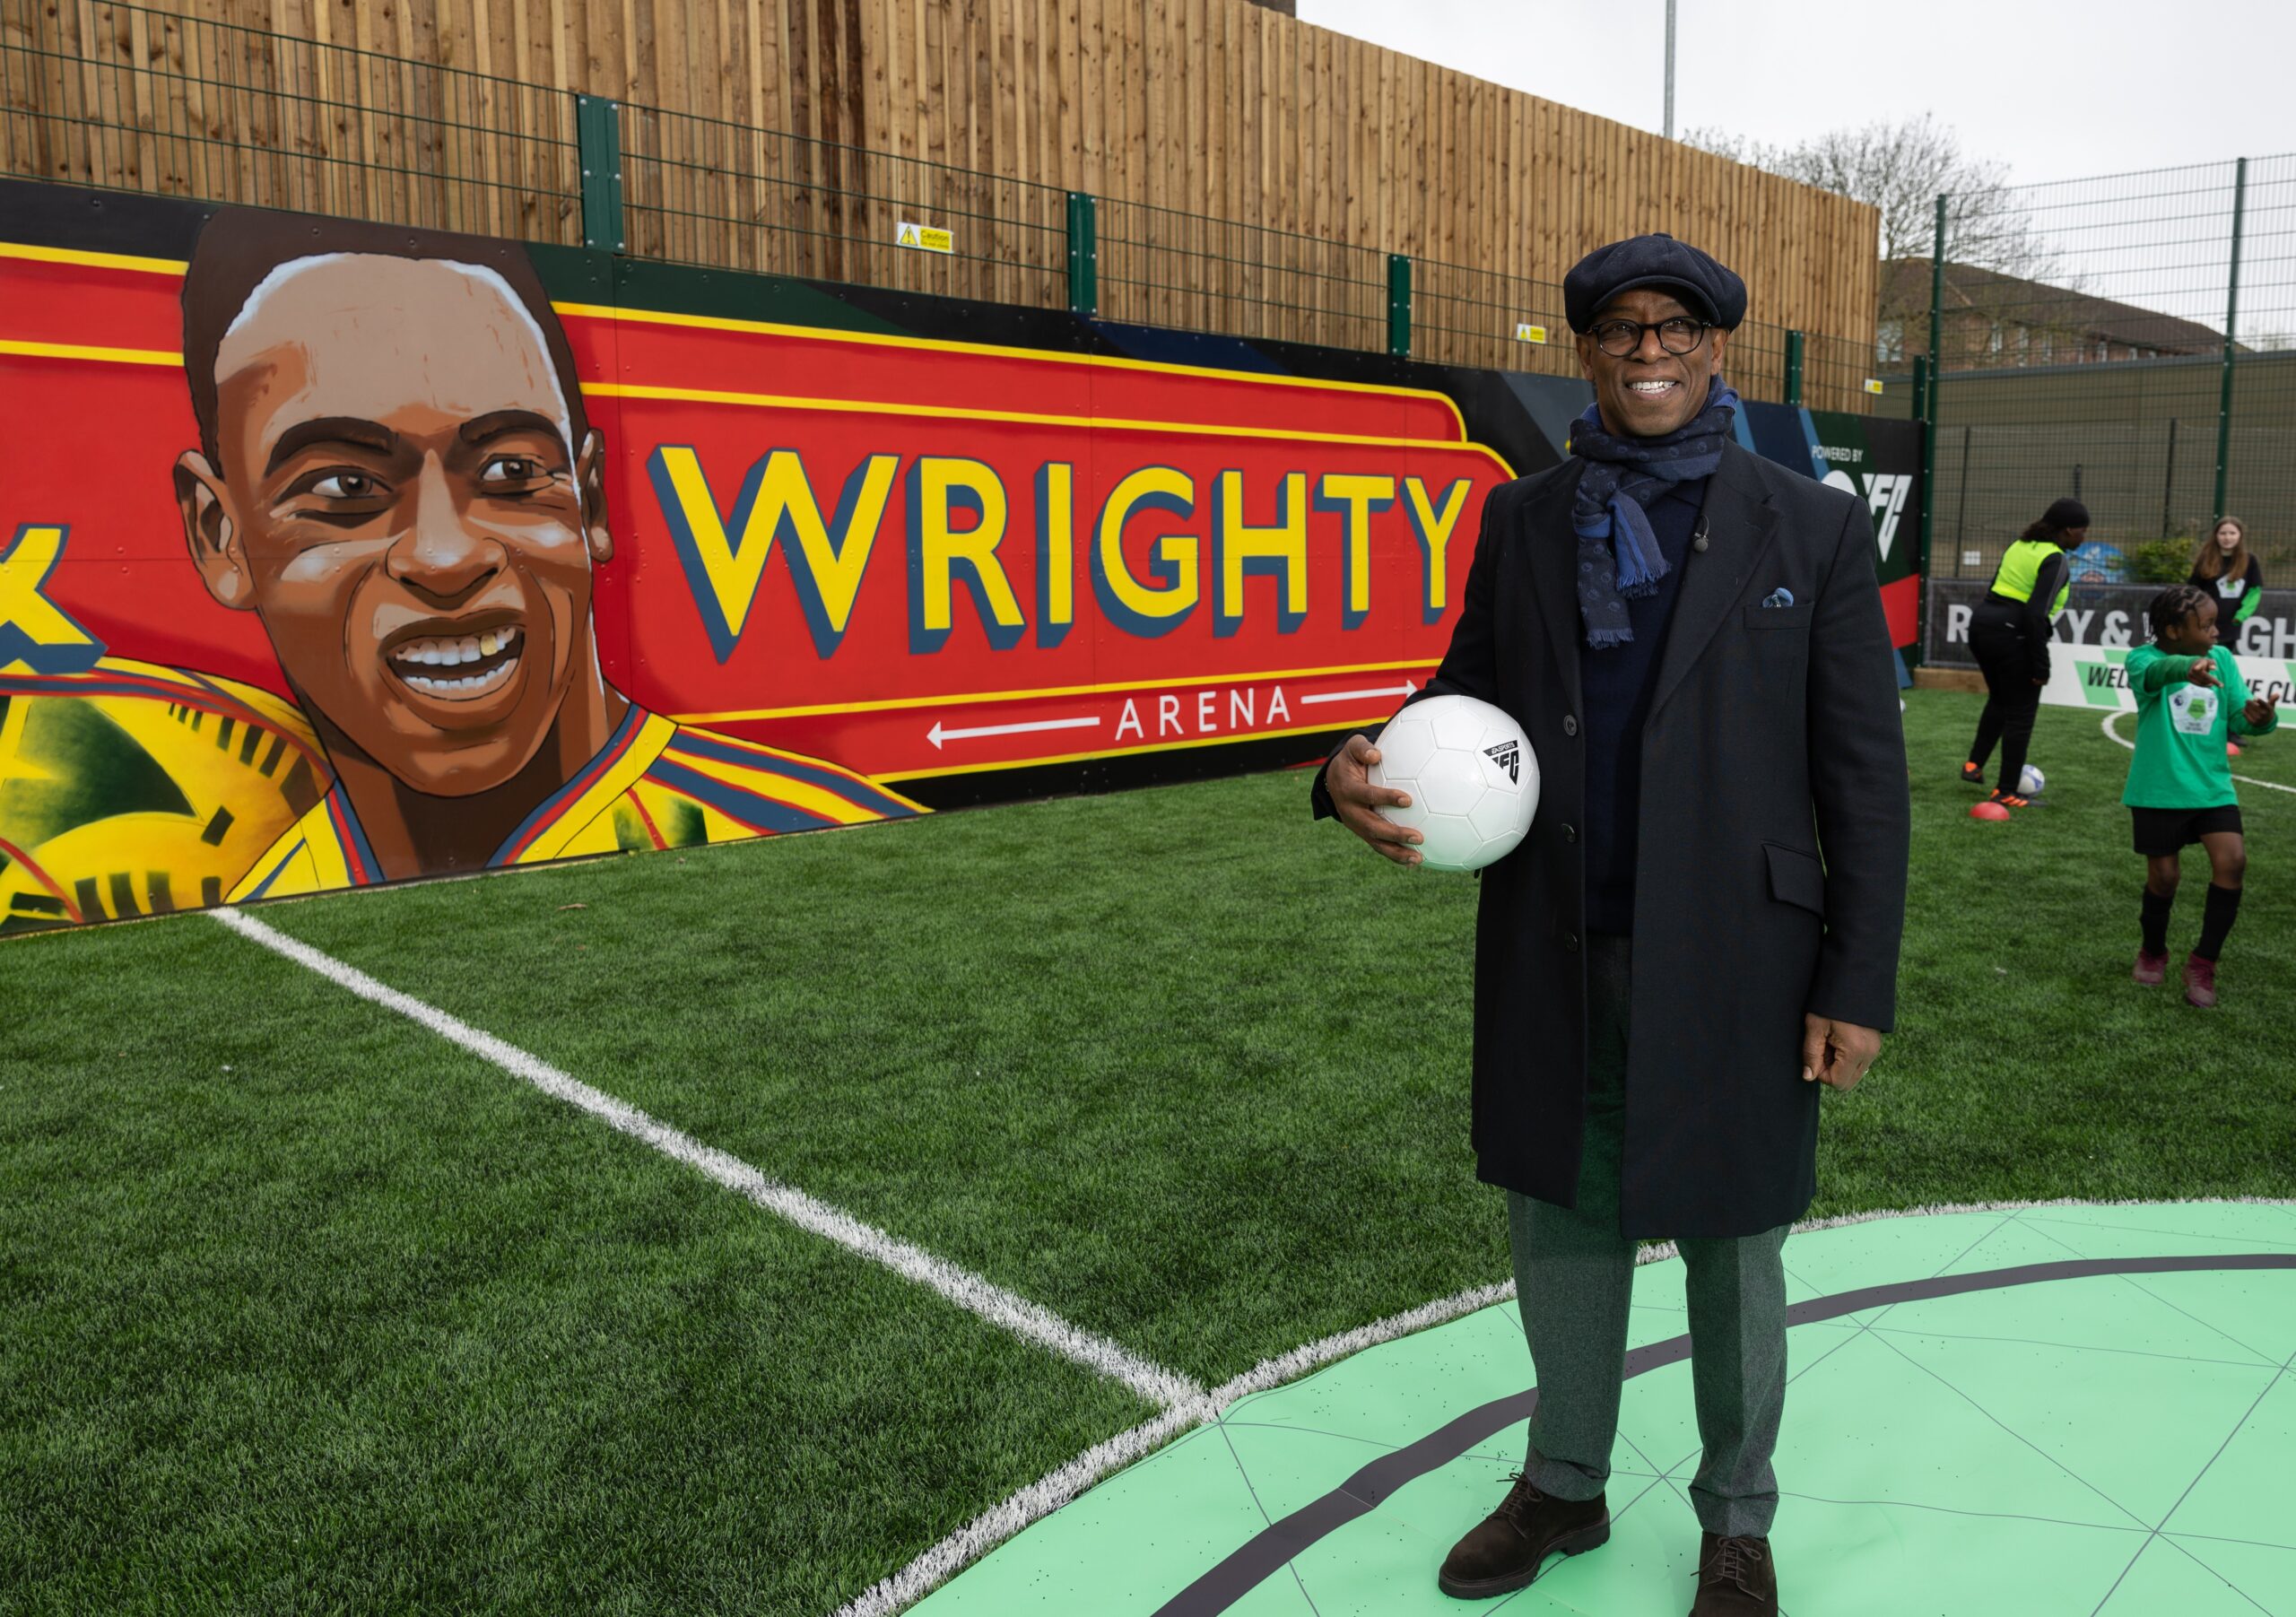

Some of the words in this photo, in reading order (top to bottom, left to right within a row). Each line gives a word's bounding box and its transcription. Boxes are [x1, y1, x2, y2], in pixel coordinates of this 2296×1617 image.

[1812, 445, 1851, 462] POWERED
[1852, 448, 1864, 462] BY
[647, 444, 1474, 660] WRIGHTY
[1115, 685, 1291, 741] ARENA
